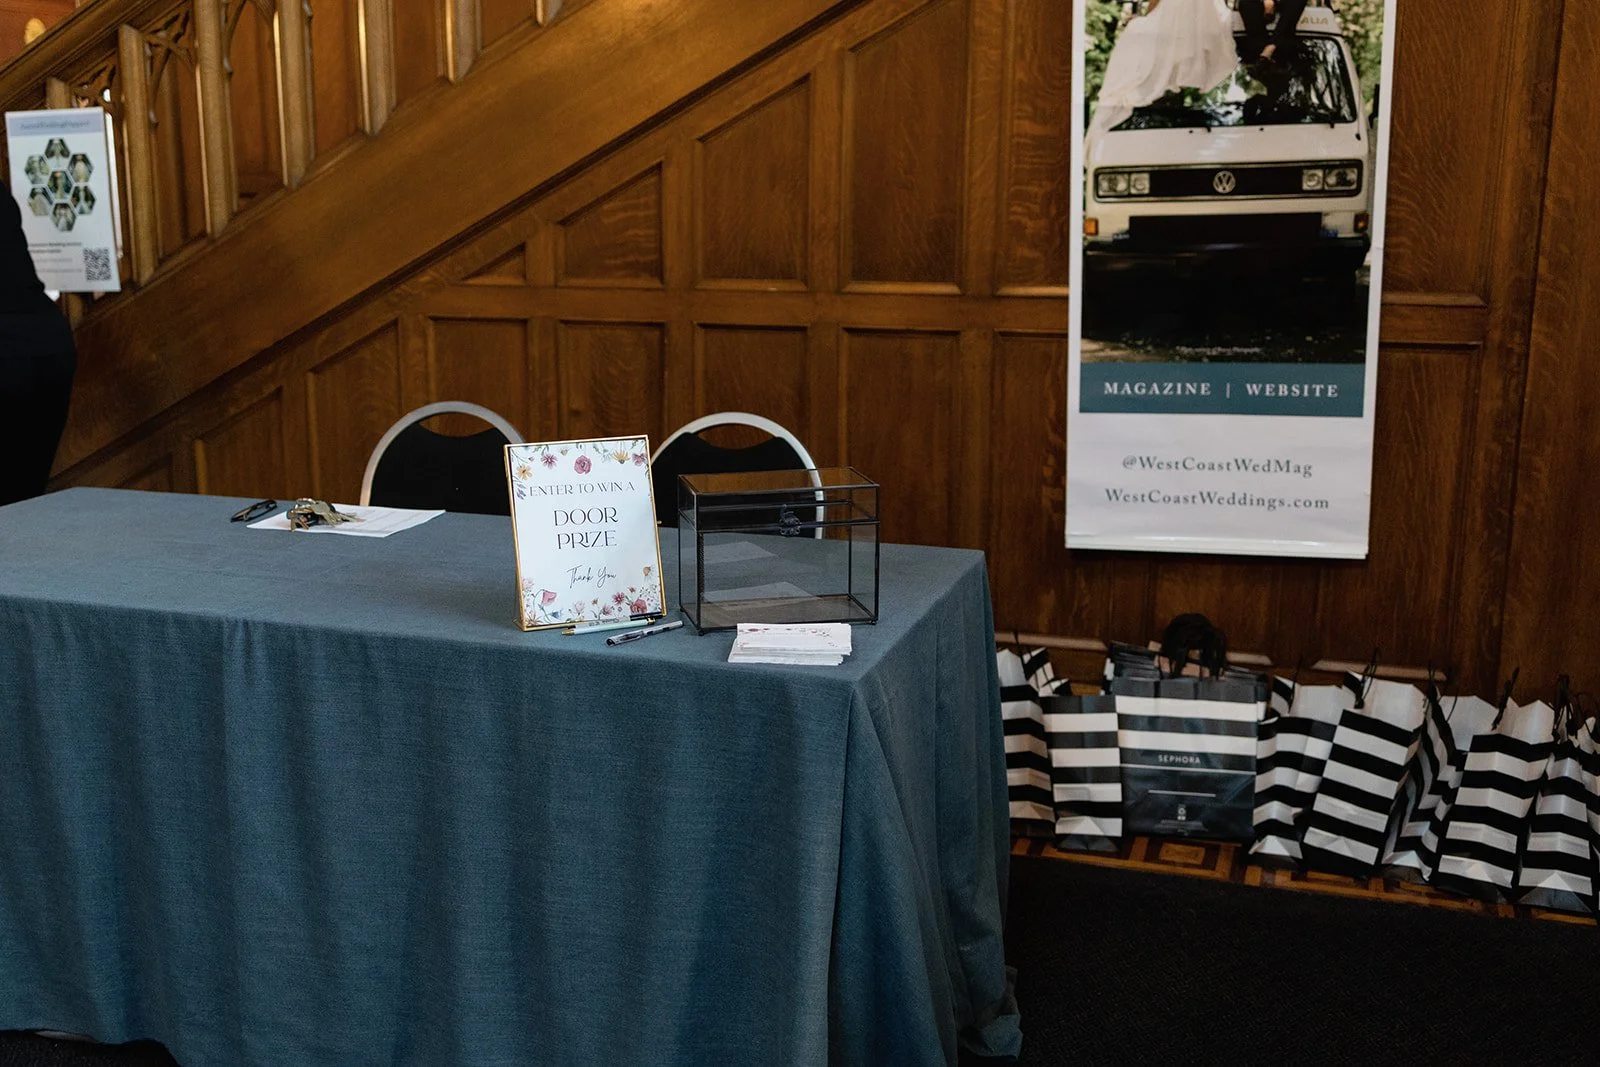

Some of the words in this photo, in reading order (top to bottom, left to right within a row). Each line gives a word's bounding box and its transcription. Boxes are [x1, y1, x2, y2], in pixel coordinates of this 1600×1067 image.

[1103, 382, 1212, 396] MAGAZINE
[1246, 383, 1339, 397] WEBSITE
[1122, 455, 1313, 478] @WestCoastWedMag
[529, 484, 573, 497] ENTER
[578, 483, 594, 494] TO
[597, 481, 623, 493] WIN
[627, 481, 635, 491] A
[1105, 488, 1330, 511] WestCoastWeddings.com
[554, 507, 618, 526] DOOR
[557, 530, 617, 549] PRIZE
[566, 565, 594, 589] Thank
[597, 566, 617, 589] You
[1158, 754, 1201, 764] SEPHORA
